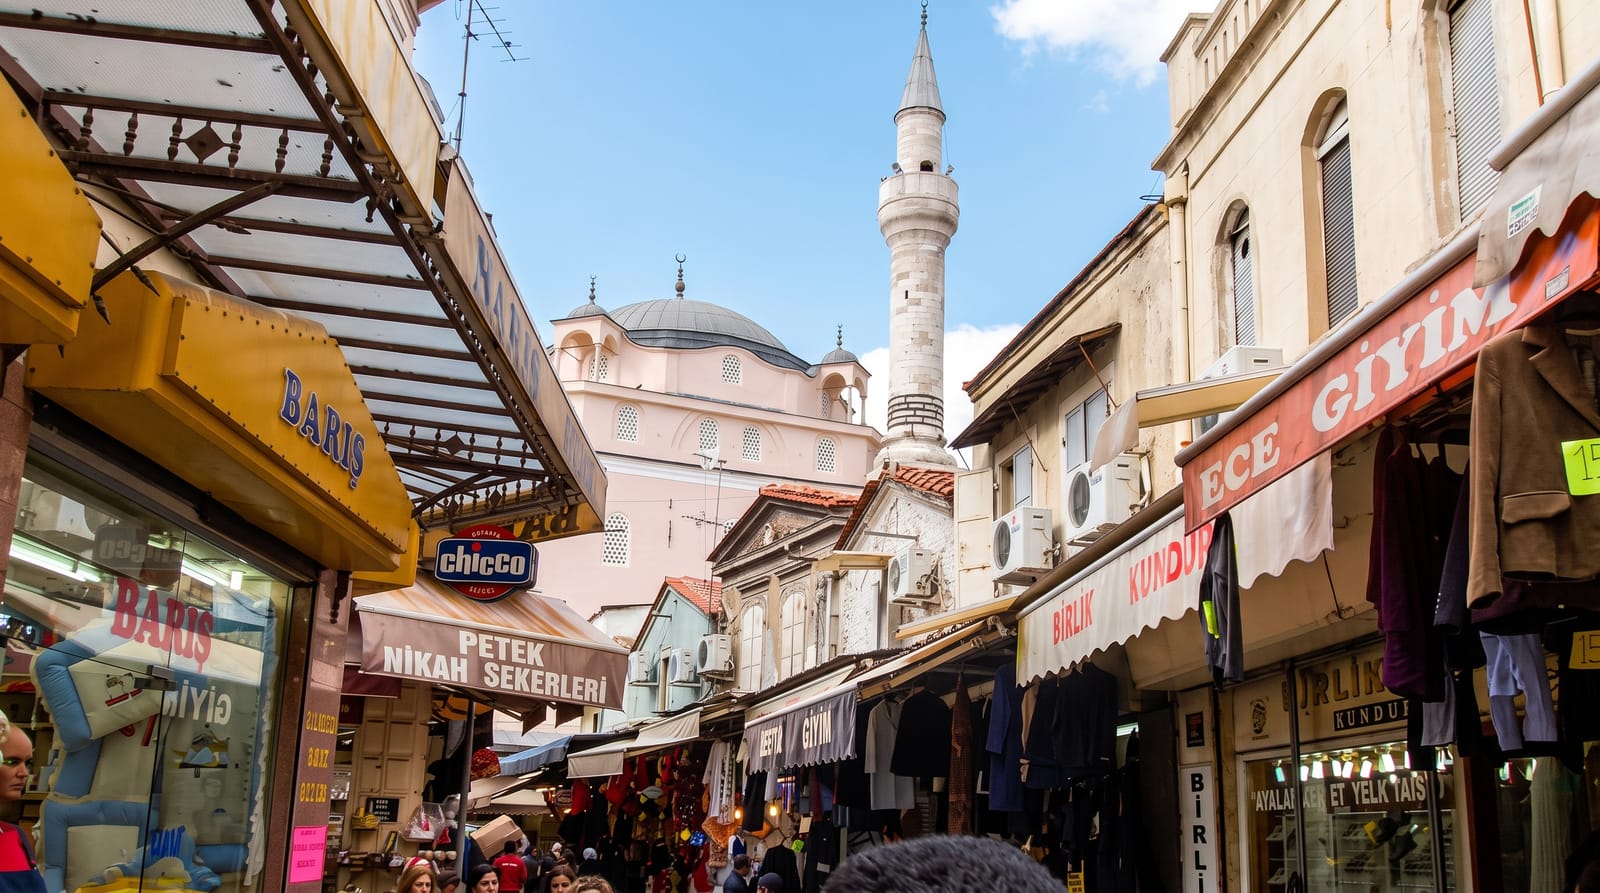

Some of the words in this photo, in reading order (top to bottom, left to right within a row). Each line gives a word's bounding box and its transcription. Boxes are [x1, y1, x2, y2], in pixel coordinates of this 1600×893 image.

[281, 367, 365, 489] BARIŞ
[1200, 422, 1280, 512] ECE
[1311, 289, 1517, 433] GİYİM
[439, 542, 526, 576] chicco
[1052, 587, 1095, 646] BİRLİK
[383, 645, 468, 684] NİKAH
[483, 662, 607, 705] SEKERLERİ
[459, 630, 545, 668] PETEK
[1330, 782, 1345, 807] ET
[1351, 778, 1390, 807] YELK
